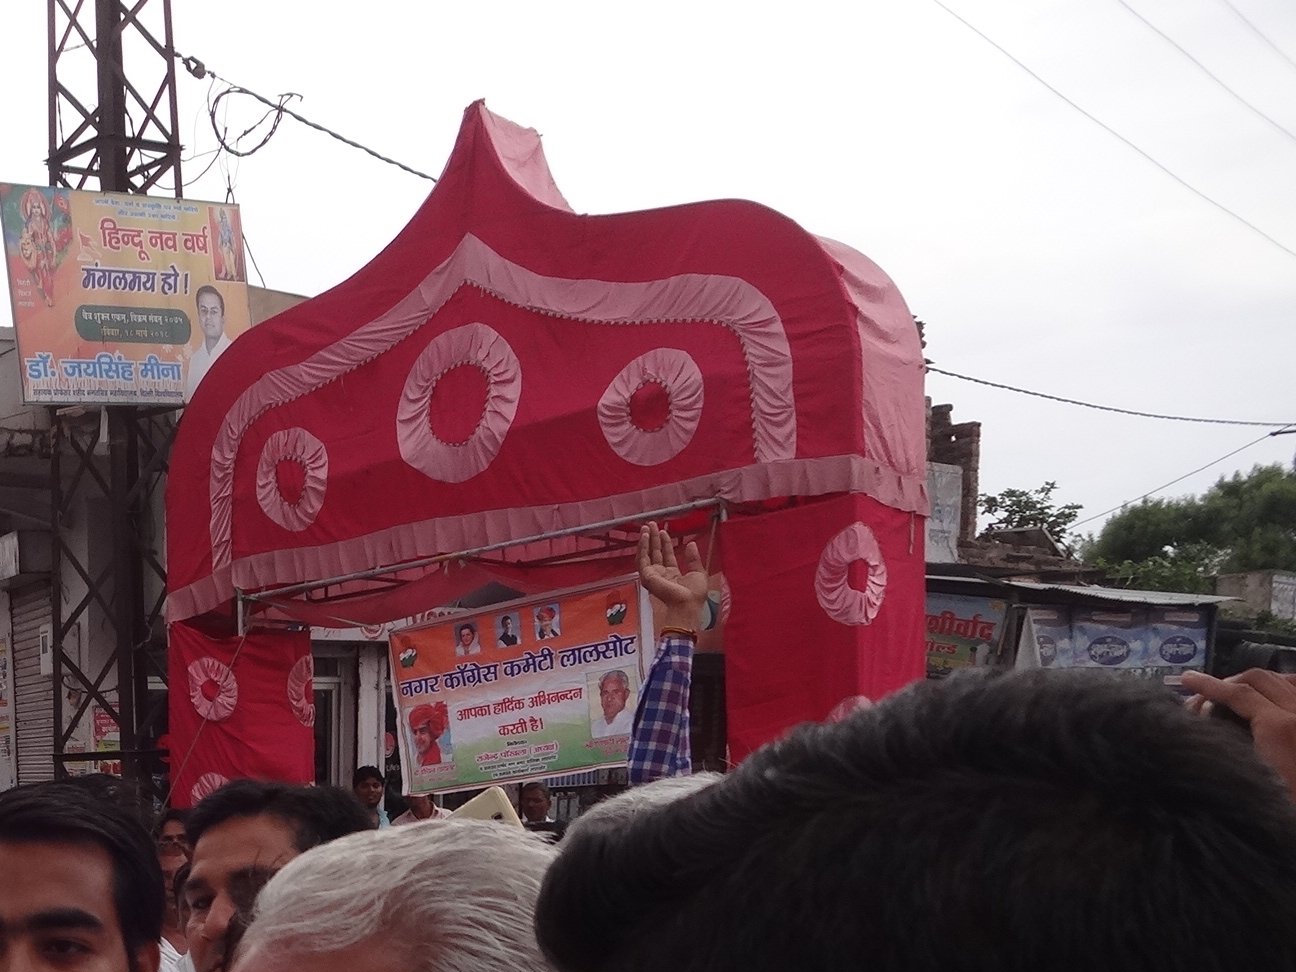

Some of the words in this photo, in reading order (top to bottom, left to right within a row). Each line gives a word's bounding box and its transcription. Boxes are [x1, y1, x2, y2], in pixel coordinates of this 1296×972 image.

[100, 218, 150, 260] हिन्दू
[148, 230, 177, 251] नव
[182, 226, 208, 253] वर्ष
[82, 262, 156, 292] मंगलमय
[161, 265, 179, 294] हो
[26, 353, 56, 379] डॉ.
[61, 353, 135, 381] जयसिंह
[139, 355, 182, 380] मीना
[925, 610, 997, 640] शीर्वाद
[401, 677, 441, 697] नगर
[503, 648, 554, 678] कमेटी
[558, 634, 636, 667] लालसोट
[456, 704, 491, 721] आपका
[493, 696, 526, 715] हार्दिक
[528, 687, 583, 708] अभिनन्दन
[498, 718, 528, 736] करती
